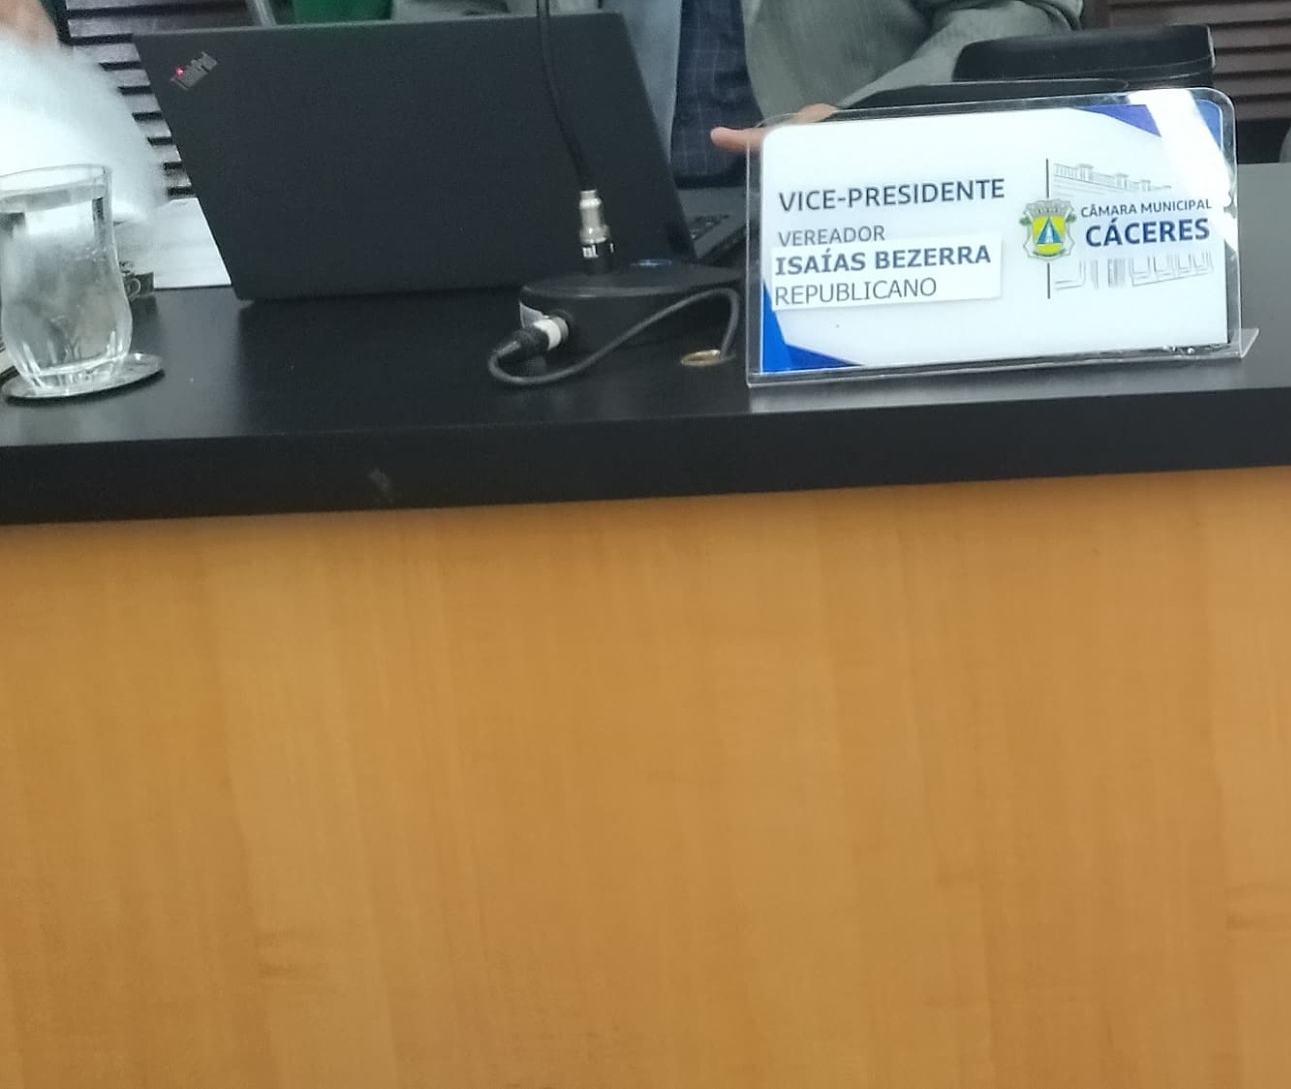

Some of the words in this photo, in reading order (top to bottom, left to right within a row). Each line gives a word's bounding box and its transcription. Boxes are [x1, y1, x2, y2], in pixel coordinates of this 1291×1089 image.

[778, 178, 1006, 213] VICE-PRESIDENTE
[1081, 203, 1136, 219] CÂMARA
[1140, 198, 1213, 215] MUNICIPAL
[778, 225, 886, 248] VEREADOR
[1085, 216, 1211, 248] CÁCERES
[774, 248, 867, 276] ISAÍAS
[875, 245, 992, 271] BEZERRA
[774, 277, 938, 307] REPUBLICANO
